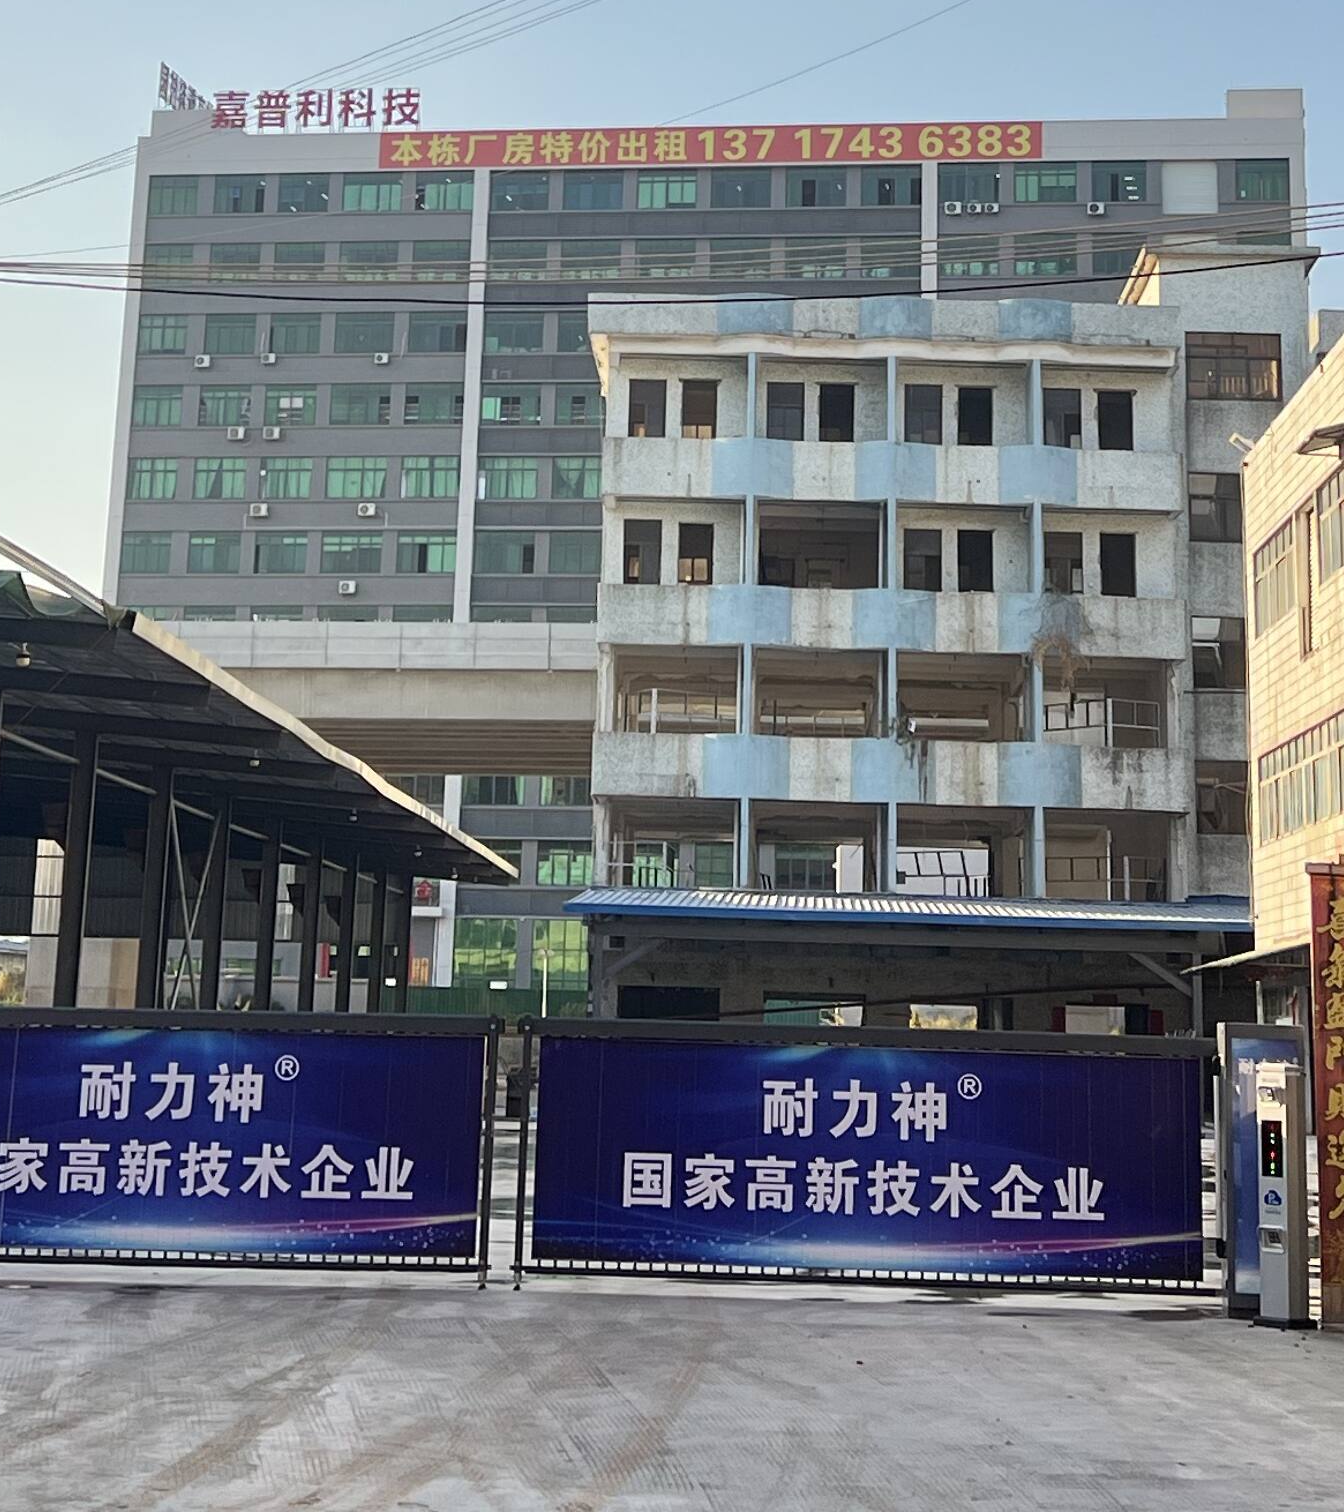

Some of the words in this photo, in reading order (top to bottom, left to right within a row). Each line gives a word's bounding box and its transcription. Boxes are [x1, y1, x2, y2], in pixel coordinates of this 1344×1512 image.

[210, 87, 422, 129] 嘉普利科技
[390, 129, 688, 166] 本栋厂房特价出租
[698, 128, 776, 161] 137
[794, 126, 904, 159] 1743
[917, 123, 1032, 157] 6383
[621, 1151, 1106, 1223] 国家高新技术企业
